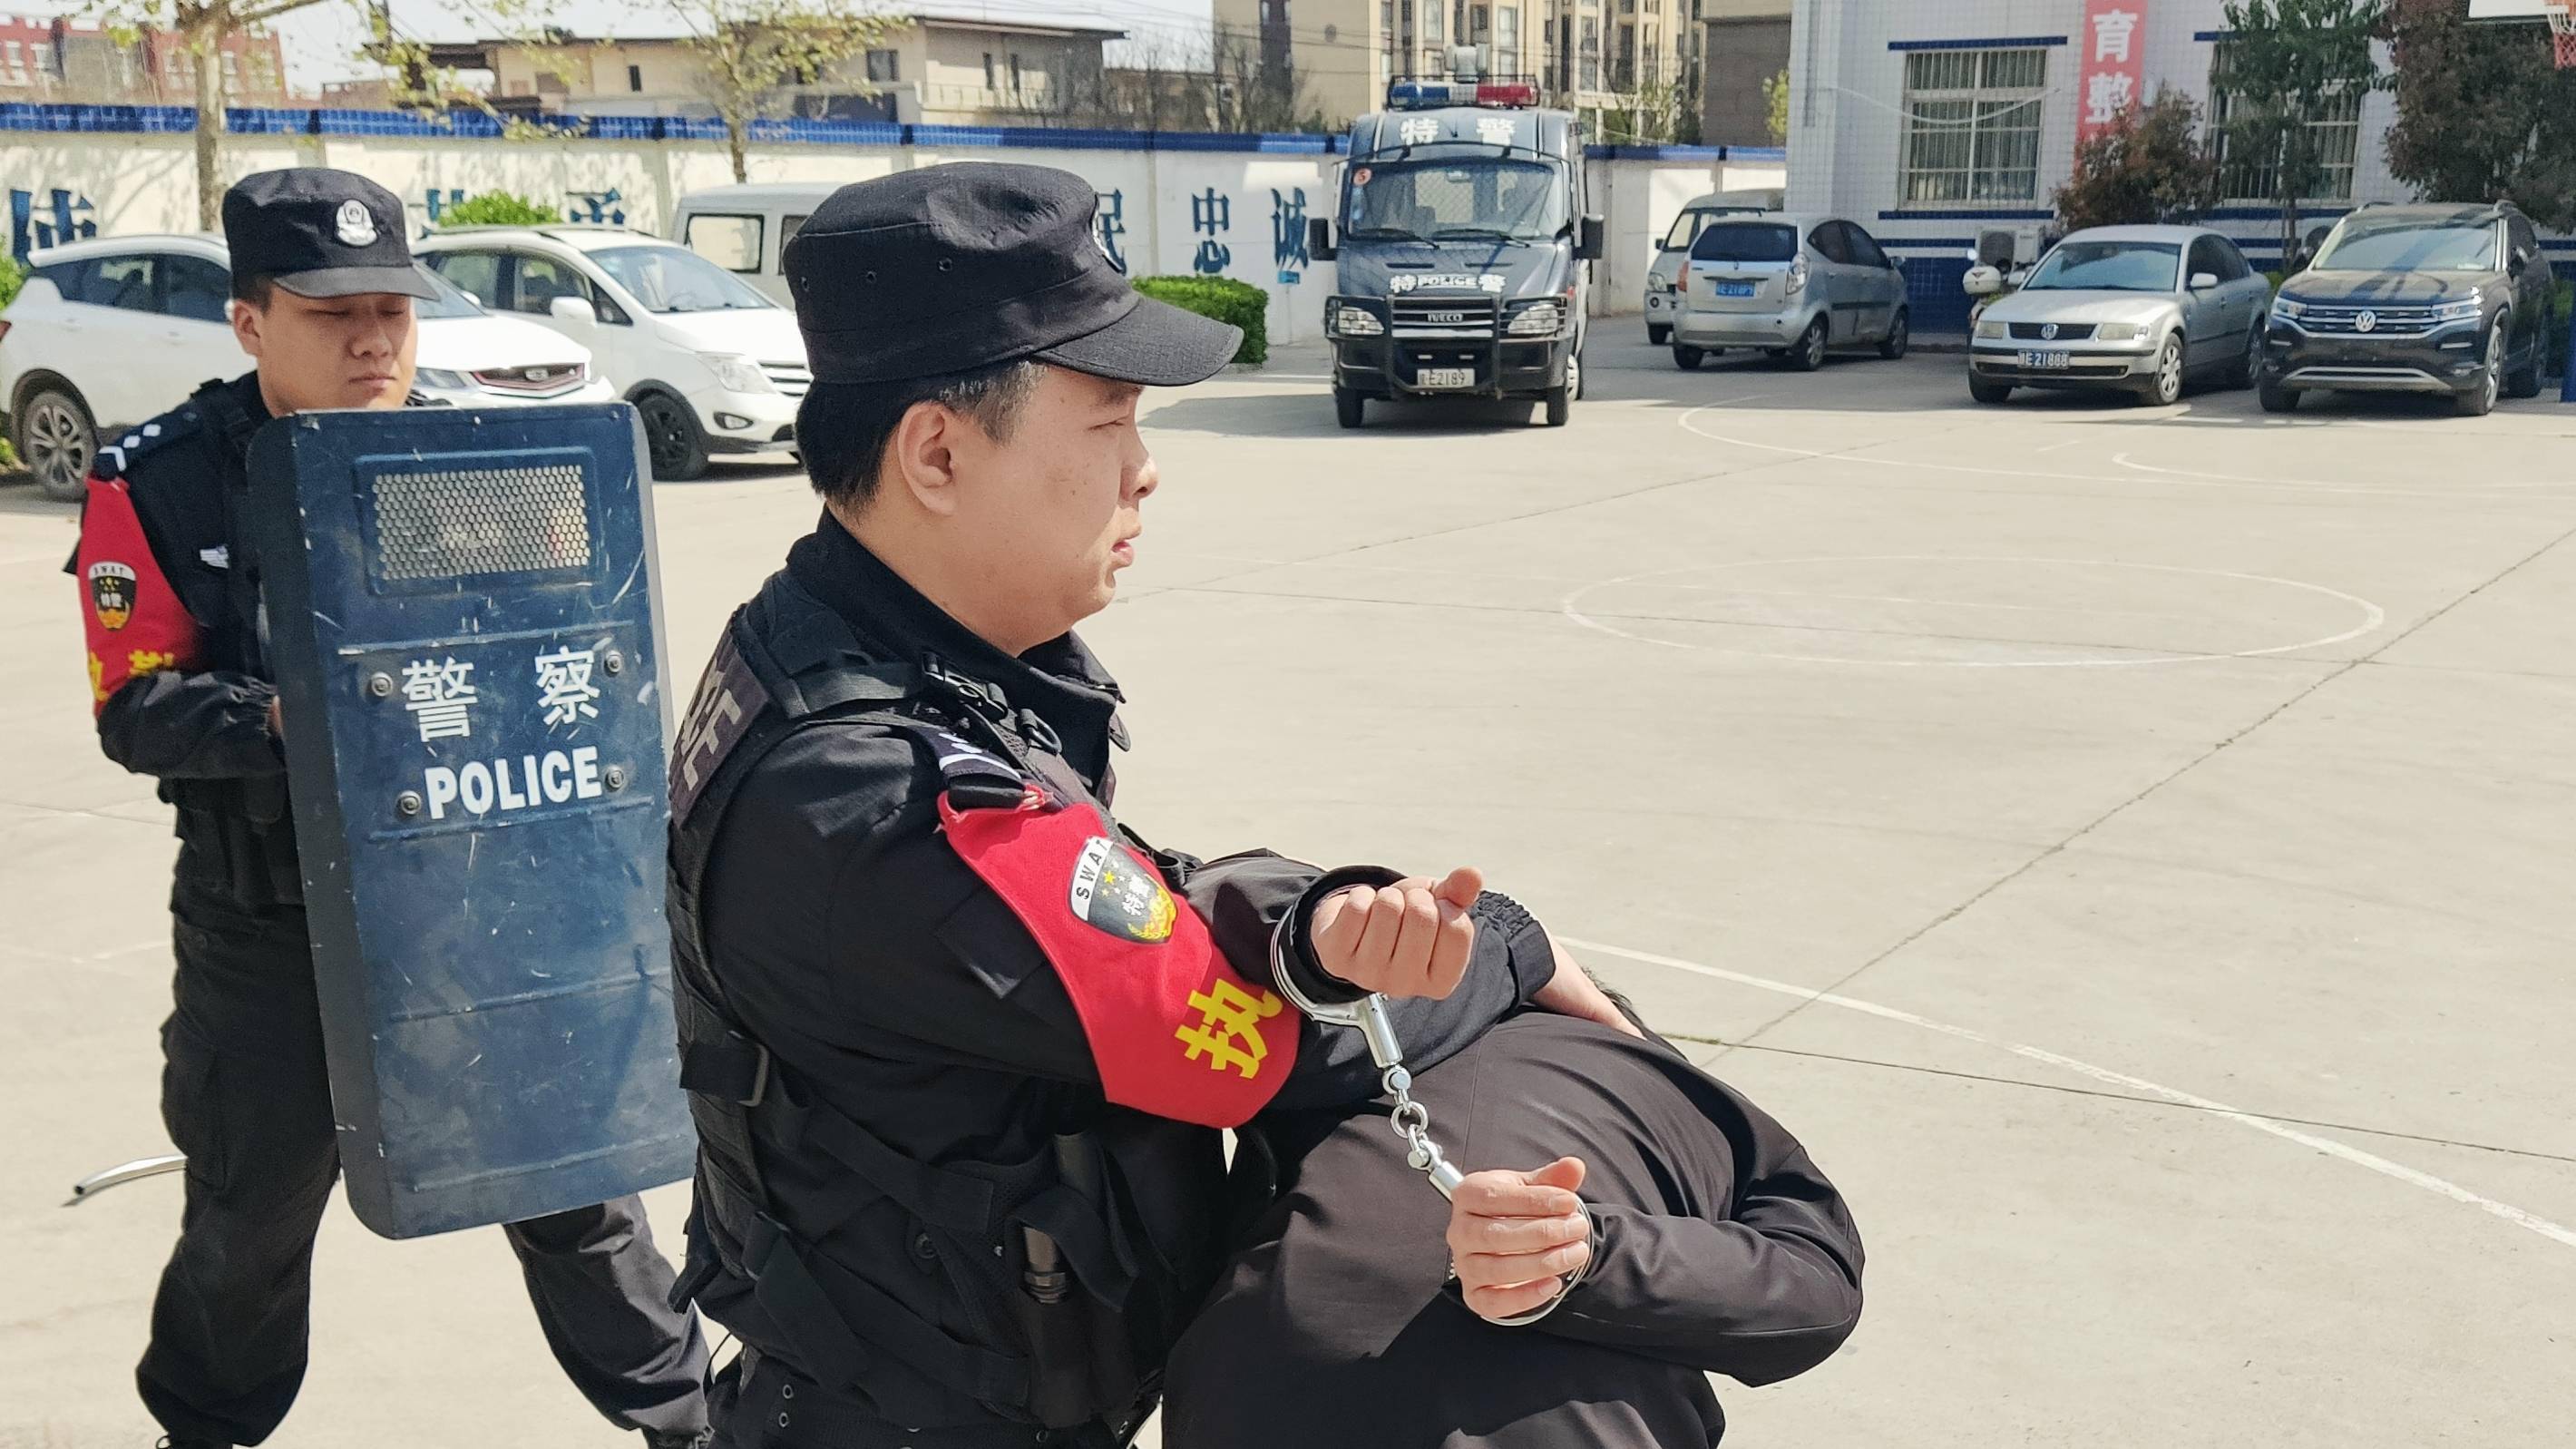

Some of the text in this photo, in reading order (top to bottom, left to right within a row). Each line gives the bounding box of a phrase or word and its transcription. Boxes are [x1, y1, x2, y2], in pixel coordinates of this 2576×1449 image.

[1417, 276, 1478, 288] POLICE
[1427, 312, 1464, 322] IVECO
[402, 645, 600, 742] 警察
[424, 746, 602, 819] POLICE
[1076, 839, 1107, 899] SWAT
[1175, 978, 1283, 1080] 执
